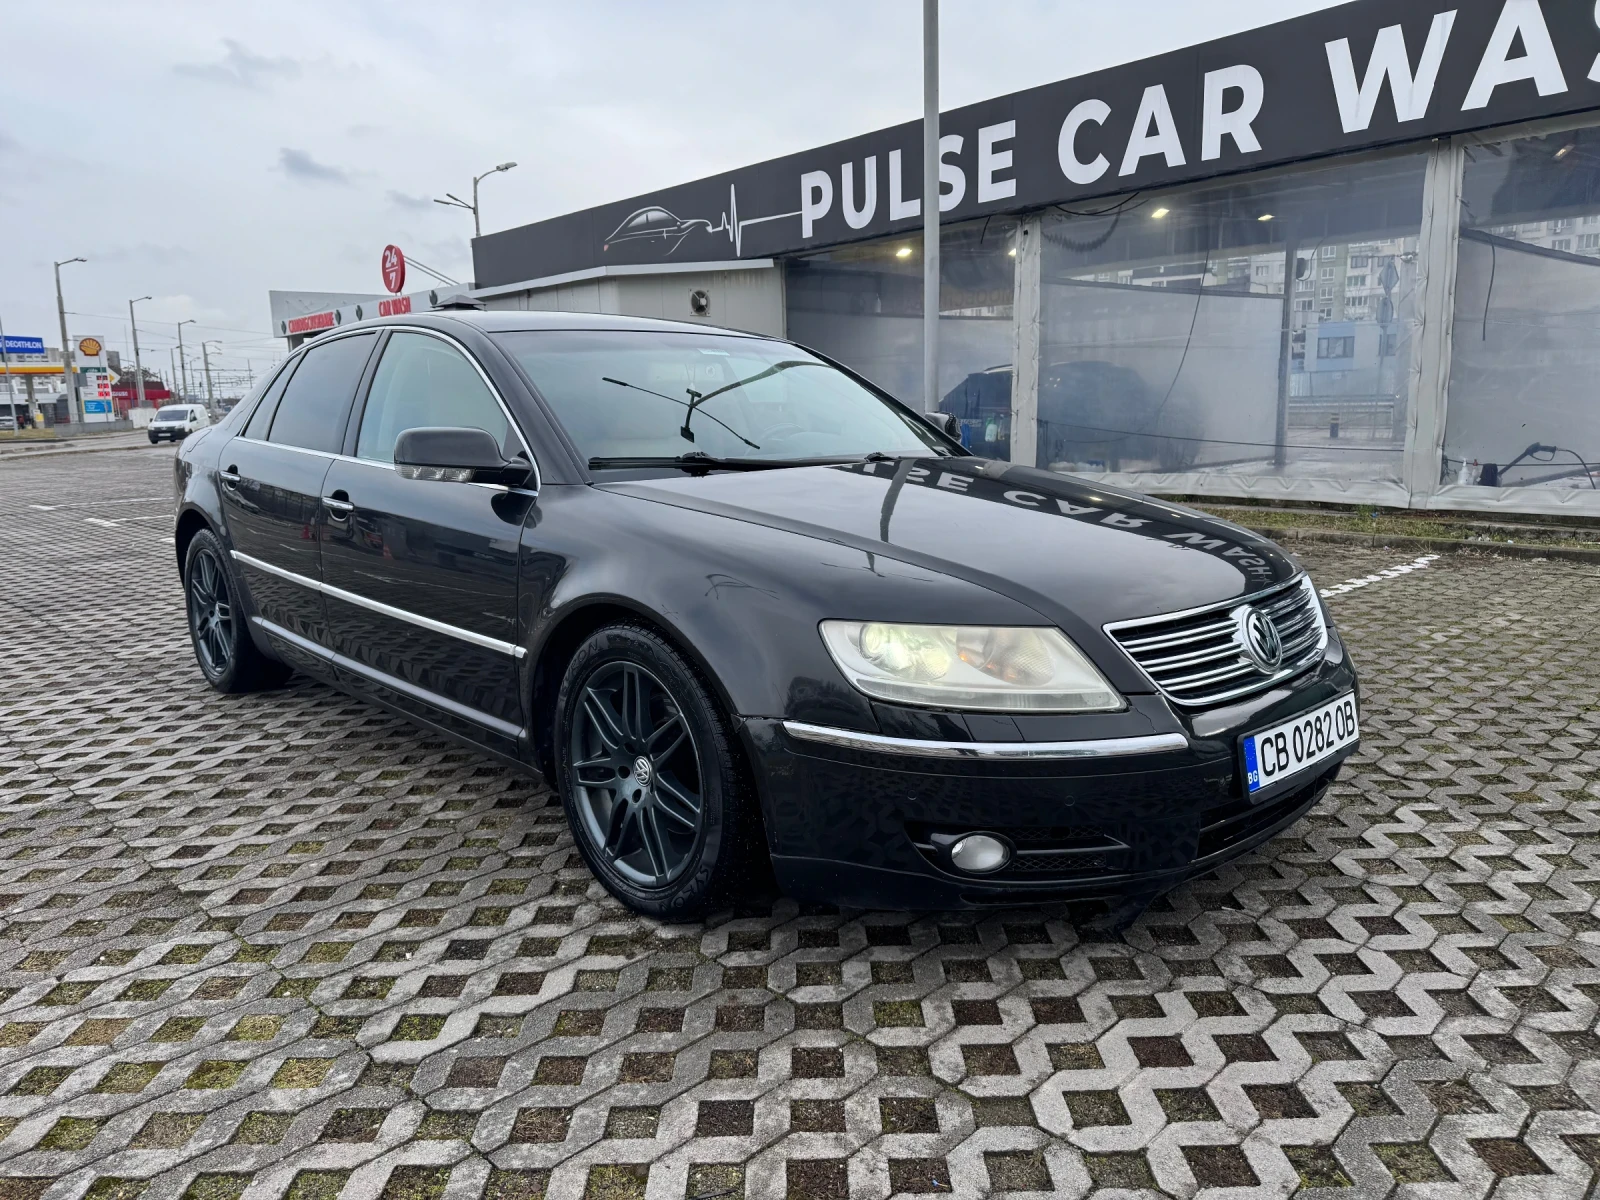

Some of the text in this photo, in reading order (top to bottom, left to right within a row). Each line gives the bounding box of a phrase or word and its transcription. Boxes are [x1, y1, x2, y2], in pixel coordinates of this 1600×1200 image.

[801, 0, 1600, 239] PULSE CAR WA
[385, 248, 398, 268] 24
[389, 271, 396, 289] 7
[378, 295, 411, 317] CAR WASH
[5, 340, 43, 349] DECATHLON
[1261, 732, 1289, 777] CB
[1293, 711, 1334, 763] 0282
[1247, 770, 1258, 784] BG
